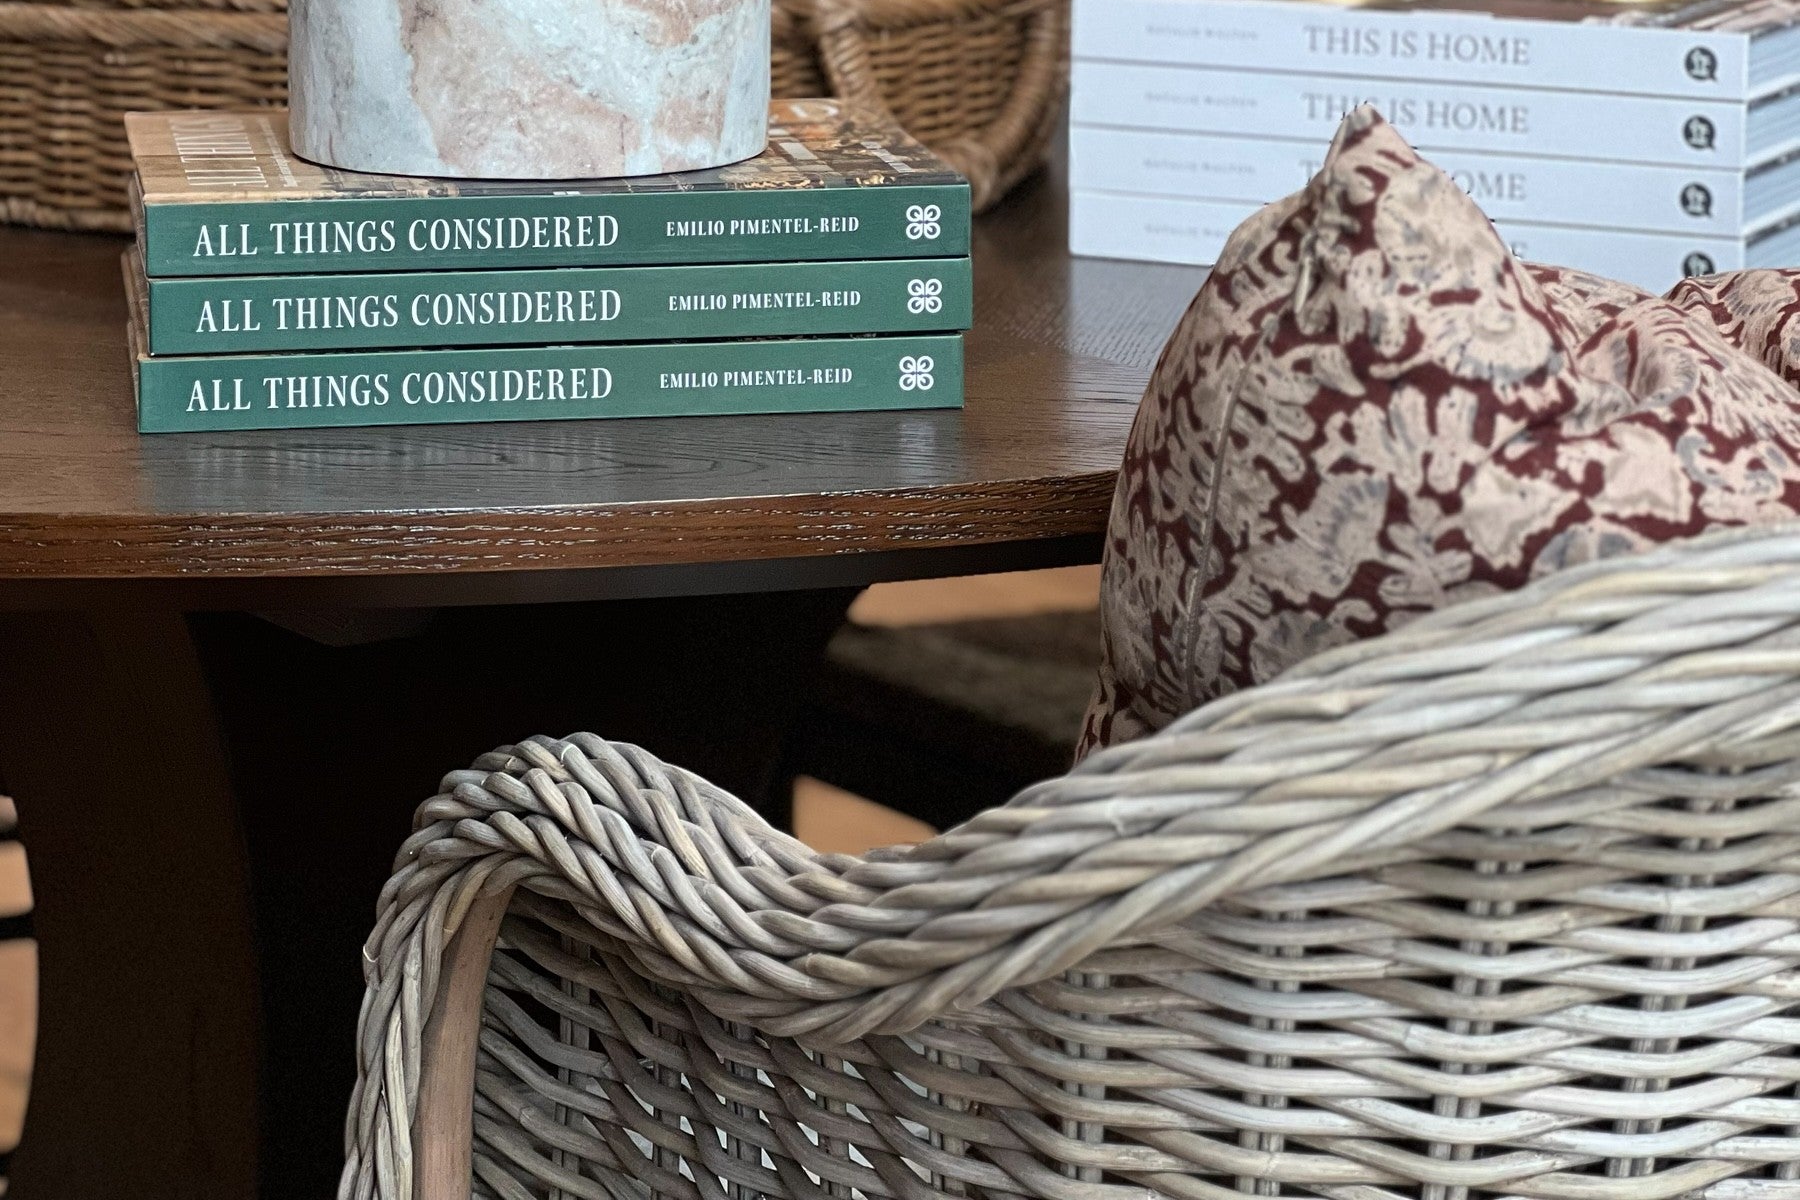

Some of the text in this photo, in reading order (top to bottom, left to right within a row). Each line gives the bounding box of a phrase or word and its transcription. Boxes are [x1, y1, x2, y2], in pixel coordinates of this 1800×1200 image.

[1302, 25, 1532, 66] THIS IS HOME
[1388, 97, 1416, 127] IS
[1426, 100, 1530, 134] HOME
[1450, 168, 1528, 202] OME
[192, 215, 619, 257] ALL THINGS CONSIDERED
[666, 216, 860, 237] EMILIO PIMENTEL-REID
[195, 289, 622, 333] ALL THINGS CONSIDERED
[668, 290, 861, 311] EMILIO PIMENTEL-REID
[185, 367, 613, 412] ALL THINGS CONSIDERED
[660, 367, 853, 389] EMILIO PIMENTEL-REID
